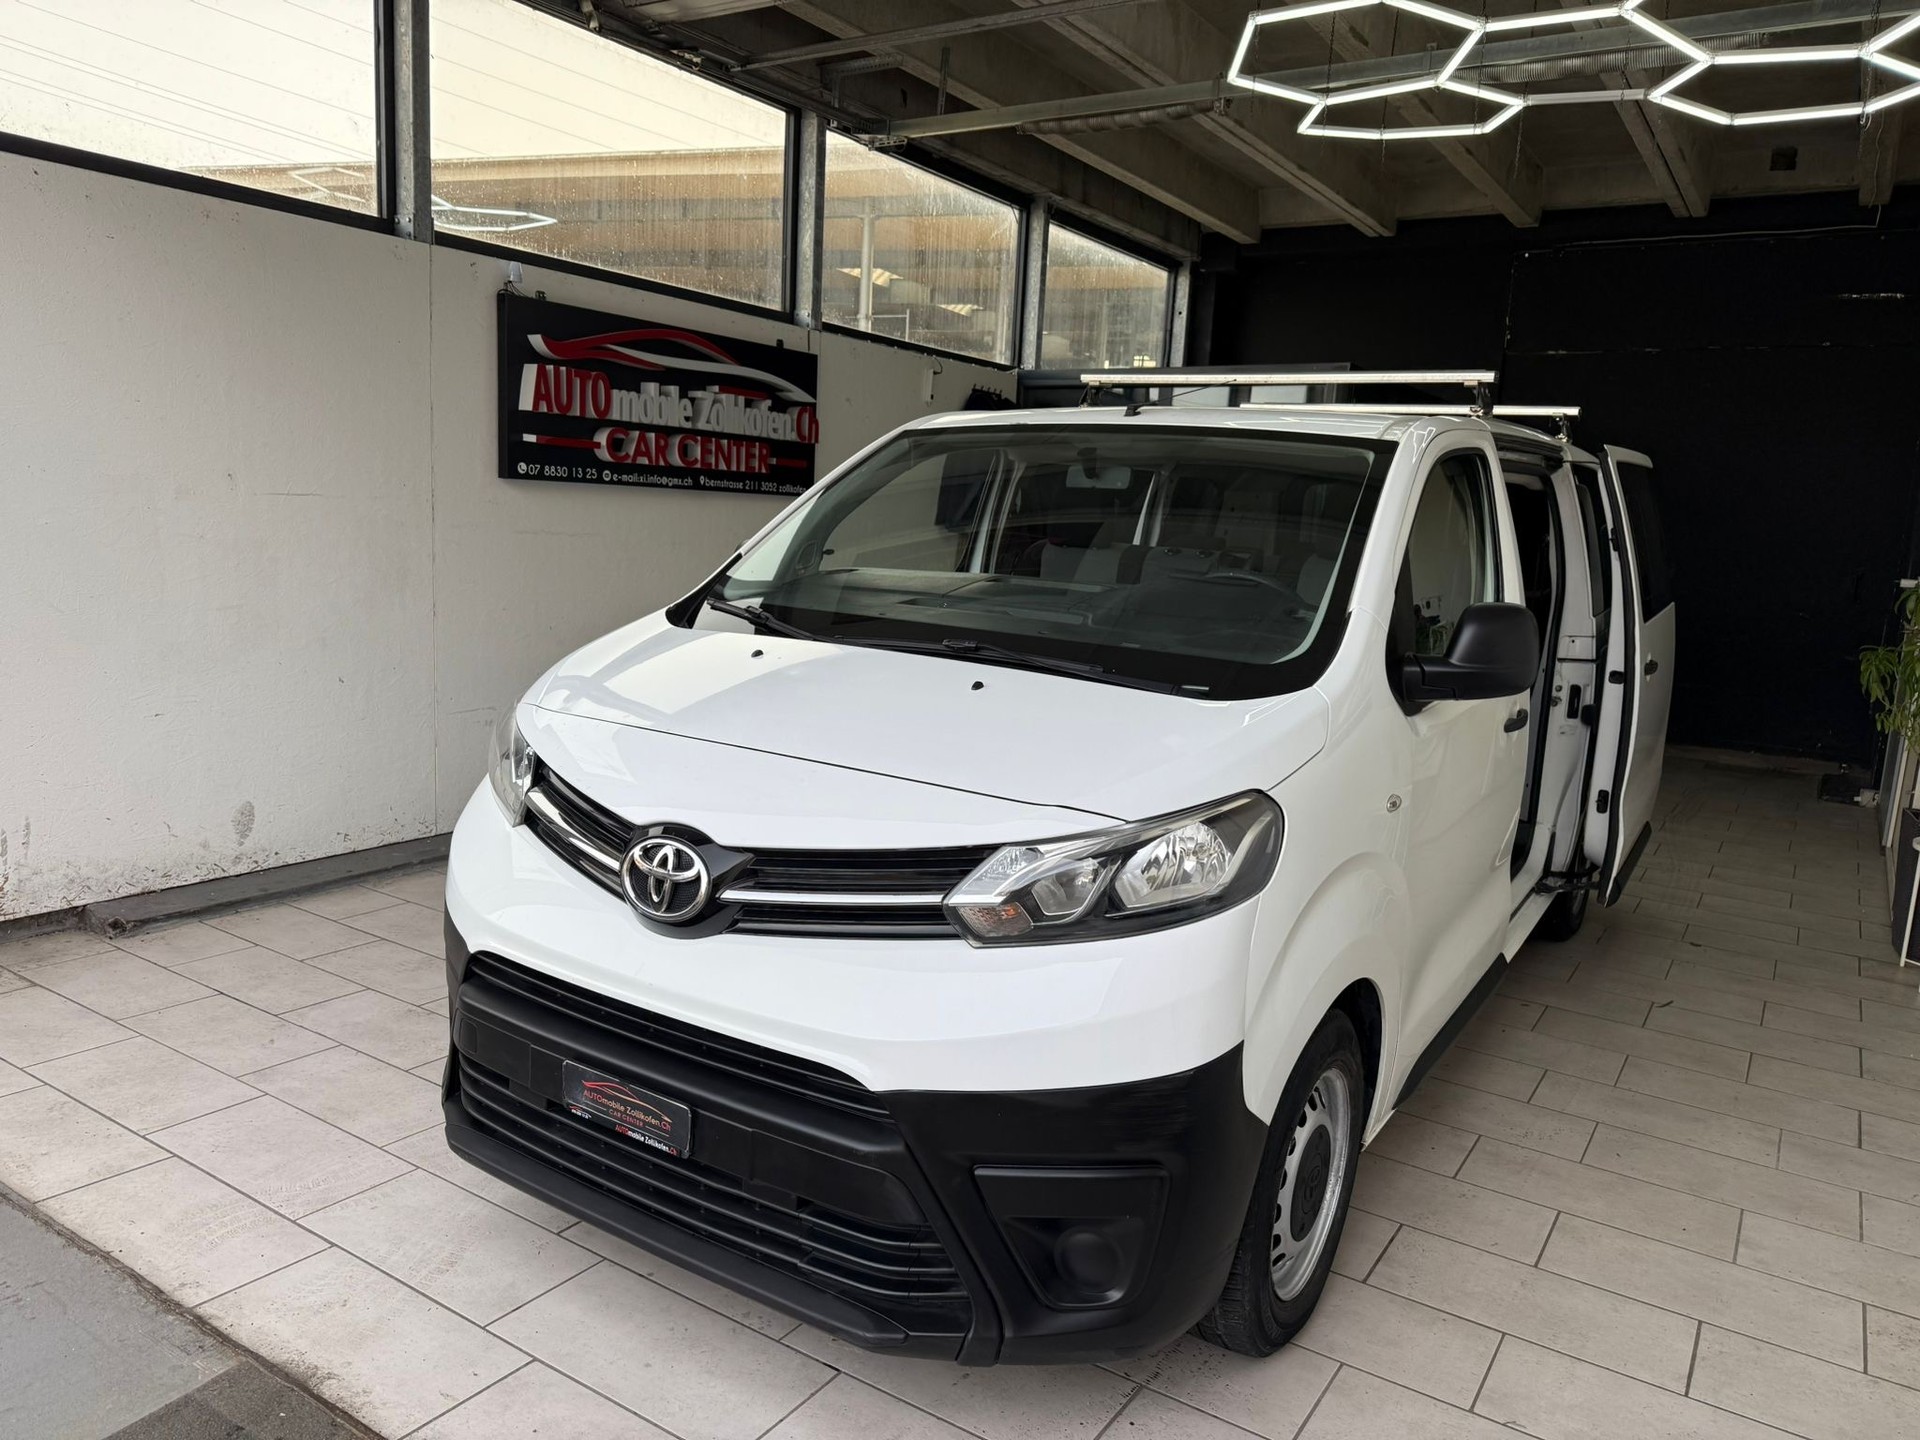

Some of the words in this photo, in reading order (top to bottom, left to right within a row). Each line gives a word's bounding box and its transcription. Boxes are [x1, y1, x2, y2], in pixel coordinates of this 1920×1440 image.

[520, 363, 693, 427] AUTOmobile
[596, 427, 669, 467] CAR
[675, 433, 771, 473] CENTER
[528, 464, 541, 475] 07
[544, 466, 569, 478] 8830
[572, 467, 583, 479] 13
[586, 468, 598, 480] 25
[705, 477, 743, 490] bernstrasse
[745, 480, 759, 491] 211
[760, 481, 777, 492] 3052
[583, 1090, 625, 1112] AUTOmobile
[608, 1109, 622, 1119] CAR
[622, 1113, 644, 1128] CENTER
